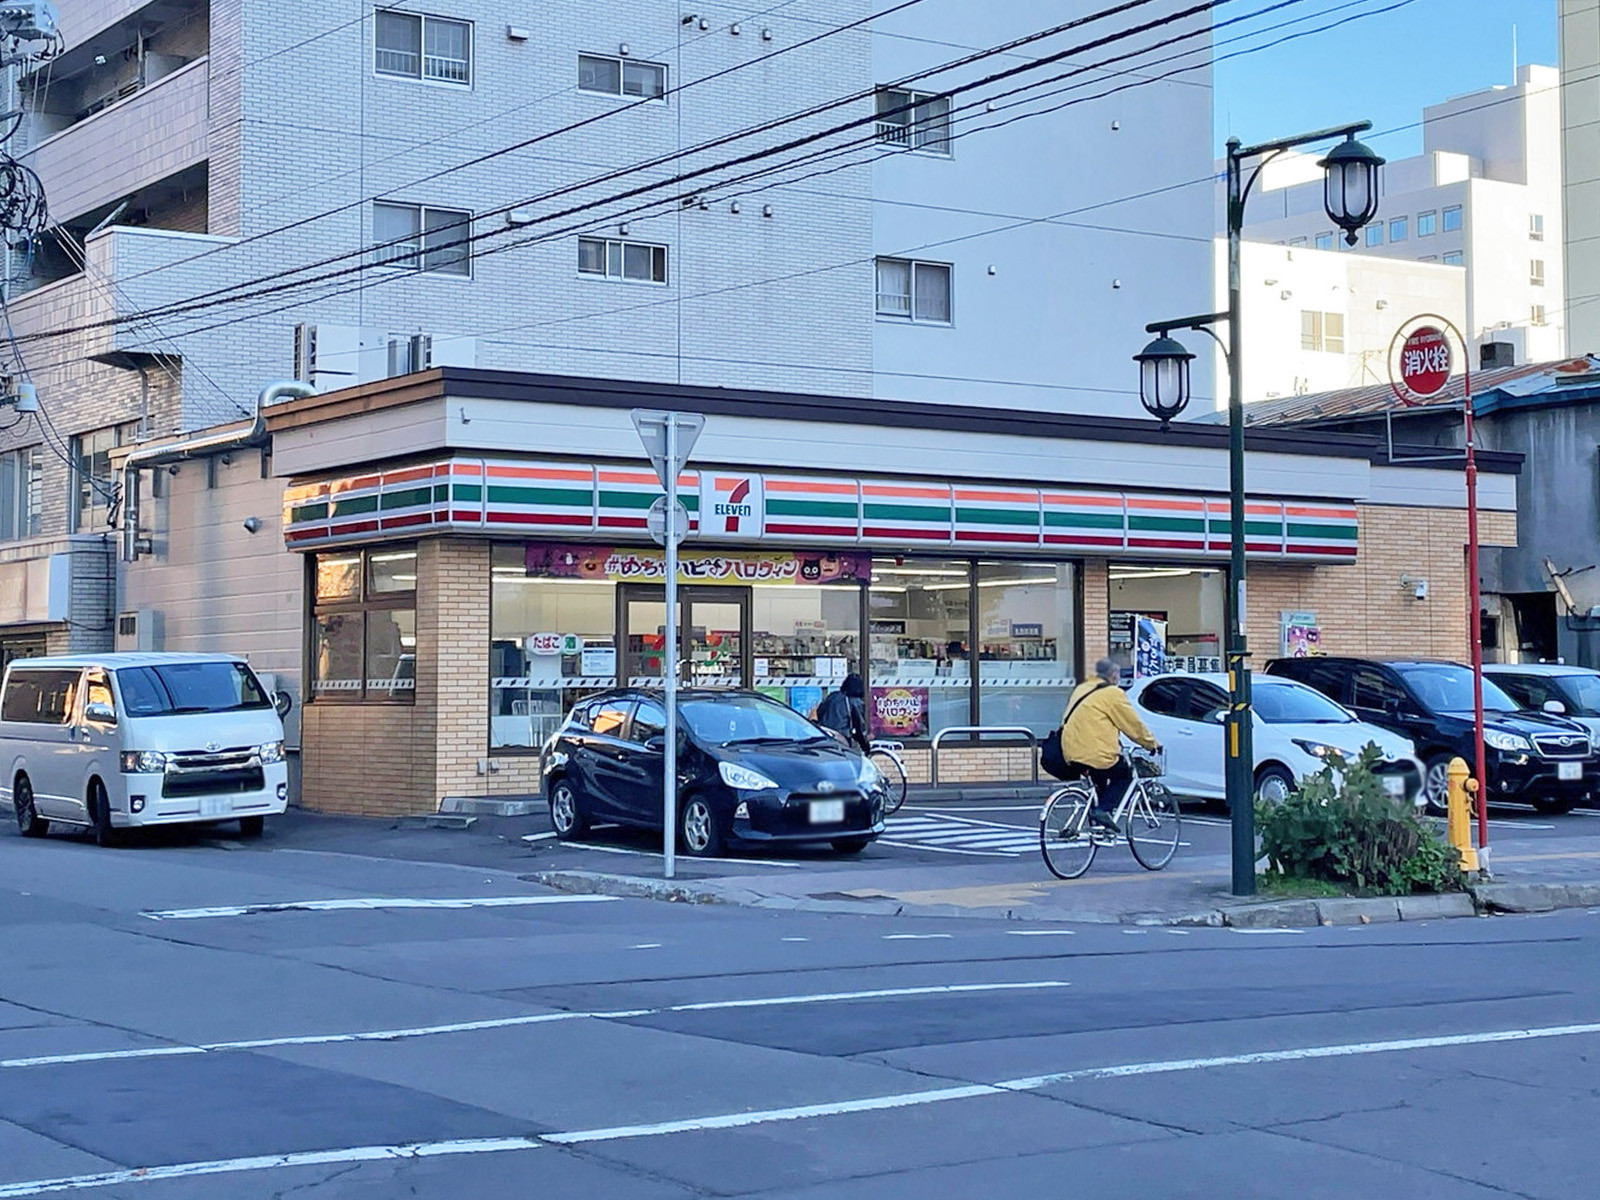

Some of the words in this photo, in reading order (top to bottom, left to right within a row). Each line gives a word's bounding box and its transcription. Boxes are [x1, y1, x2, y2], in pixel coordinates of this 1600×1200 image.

[1404, 344, 1449, 377] 消火栓
[533, 636, 560, 649] たばこ
